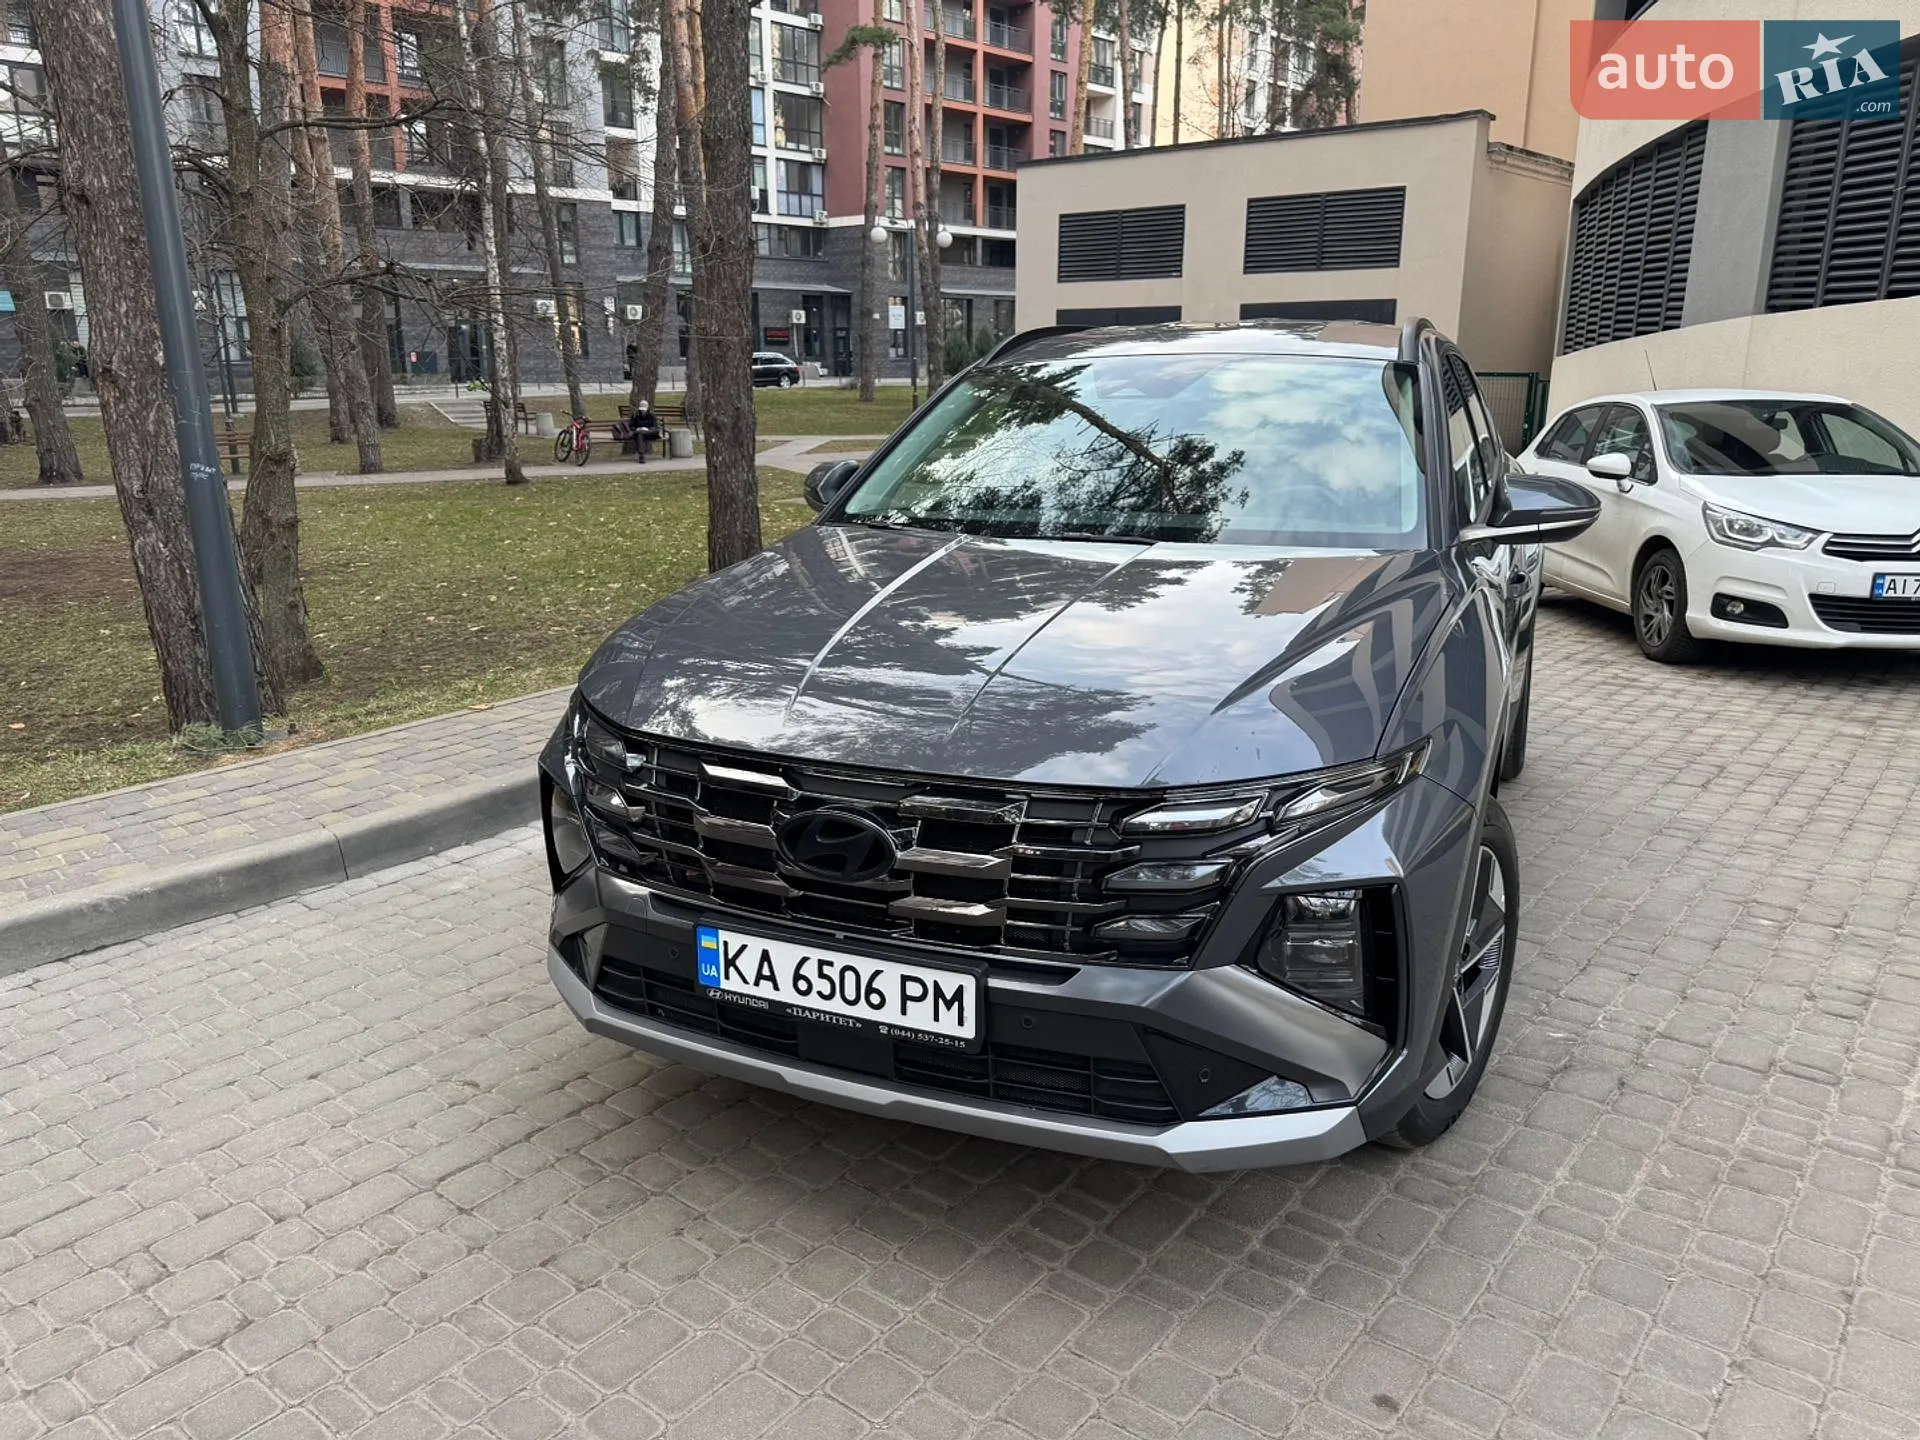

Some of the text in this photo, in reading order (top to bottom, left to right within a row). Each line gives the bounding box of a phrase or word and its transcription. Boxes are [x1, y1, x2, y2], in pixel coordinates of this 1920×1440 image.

[701, 963, 719, 978] UA
[722, 940, 965, 1026] KA 6506 PM
[724, 991, 769, 1010] HYUNDAI
